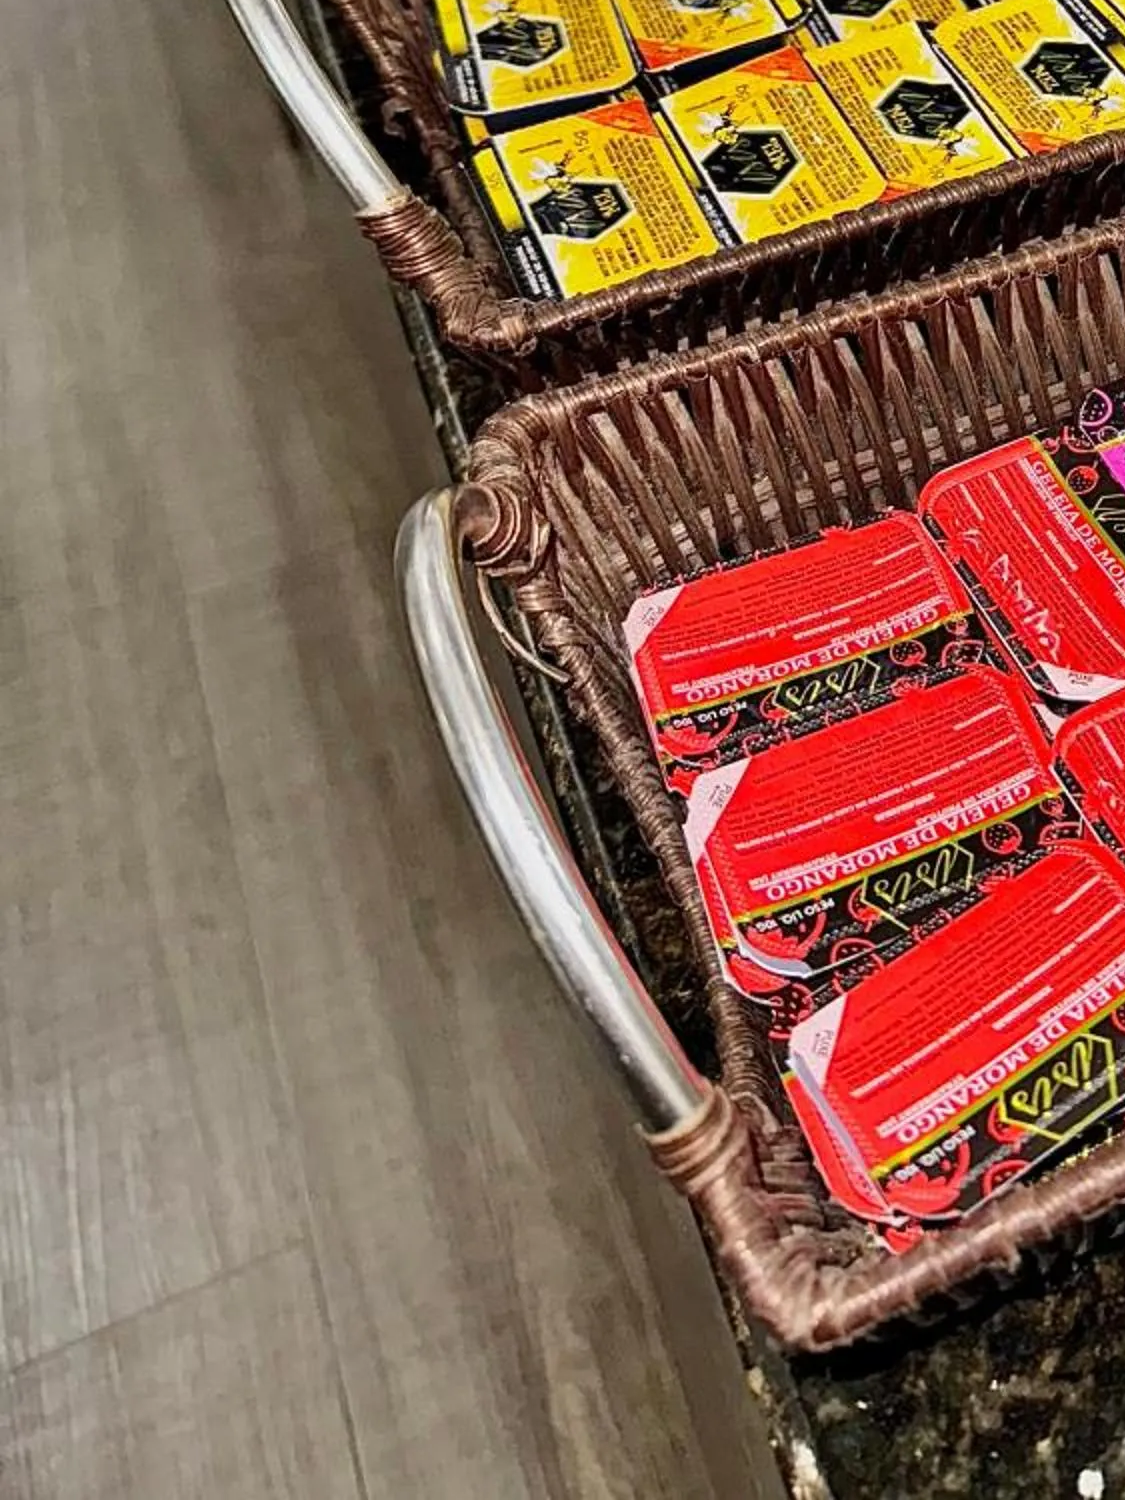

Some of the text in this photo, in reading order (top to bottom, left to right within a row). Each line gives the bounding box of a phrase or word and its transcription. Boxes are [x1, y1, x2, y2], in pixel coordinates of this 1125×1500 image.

[761, 137, 790, 170] MEL
[592, 188, 620, 219] MEL
[1030, 459, 1084, 523] GELEIA
[1075, 523, 1103, 548] DE
[814, 641, 851, 664] DE
[847, 606, 940, 653] GELEIA
[684, 653, 813, 706] MORANGO
[763, 780, 1032, 904] GELEIA DE MORANGO
[872, 843, 956, 908] isis
[1027, 1017, 1067, 1054] DE
[895, 1044, 1028, 1147] MORANGO
[1010, 1038, 1096, 1118] isis
